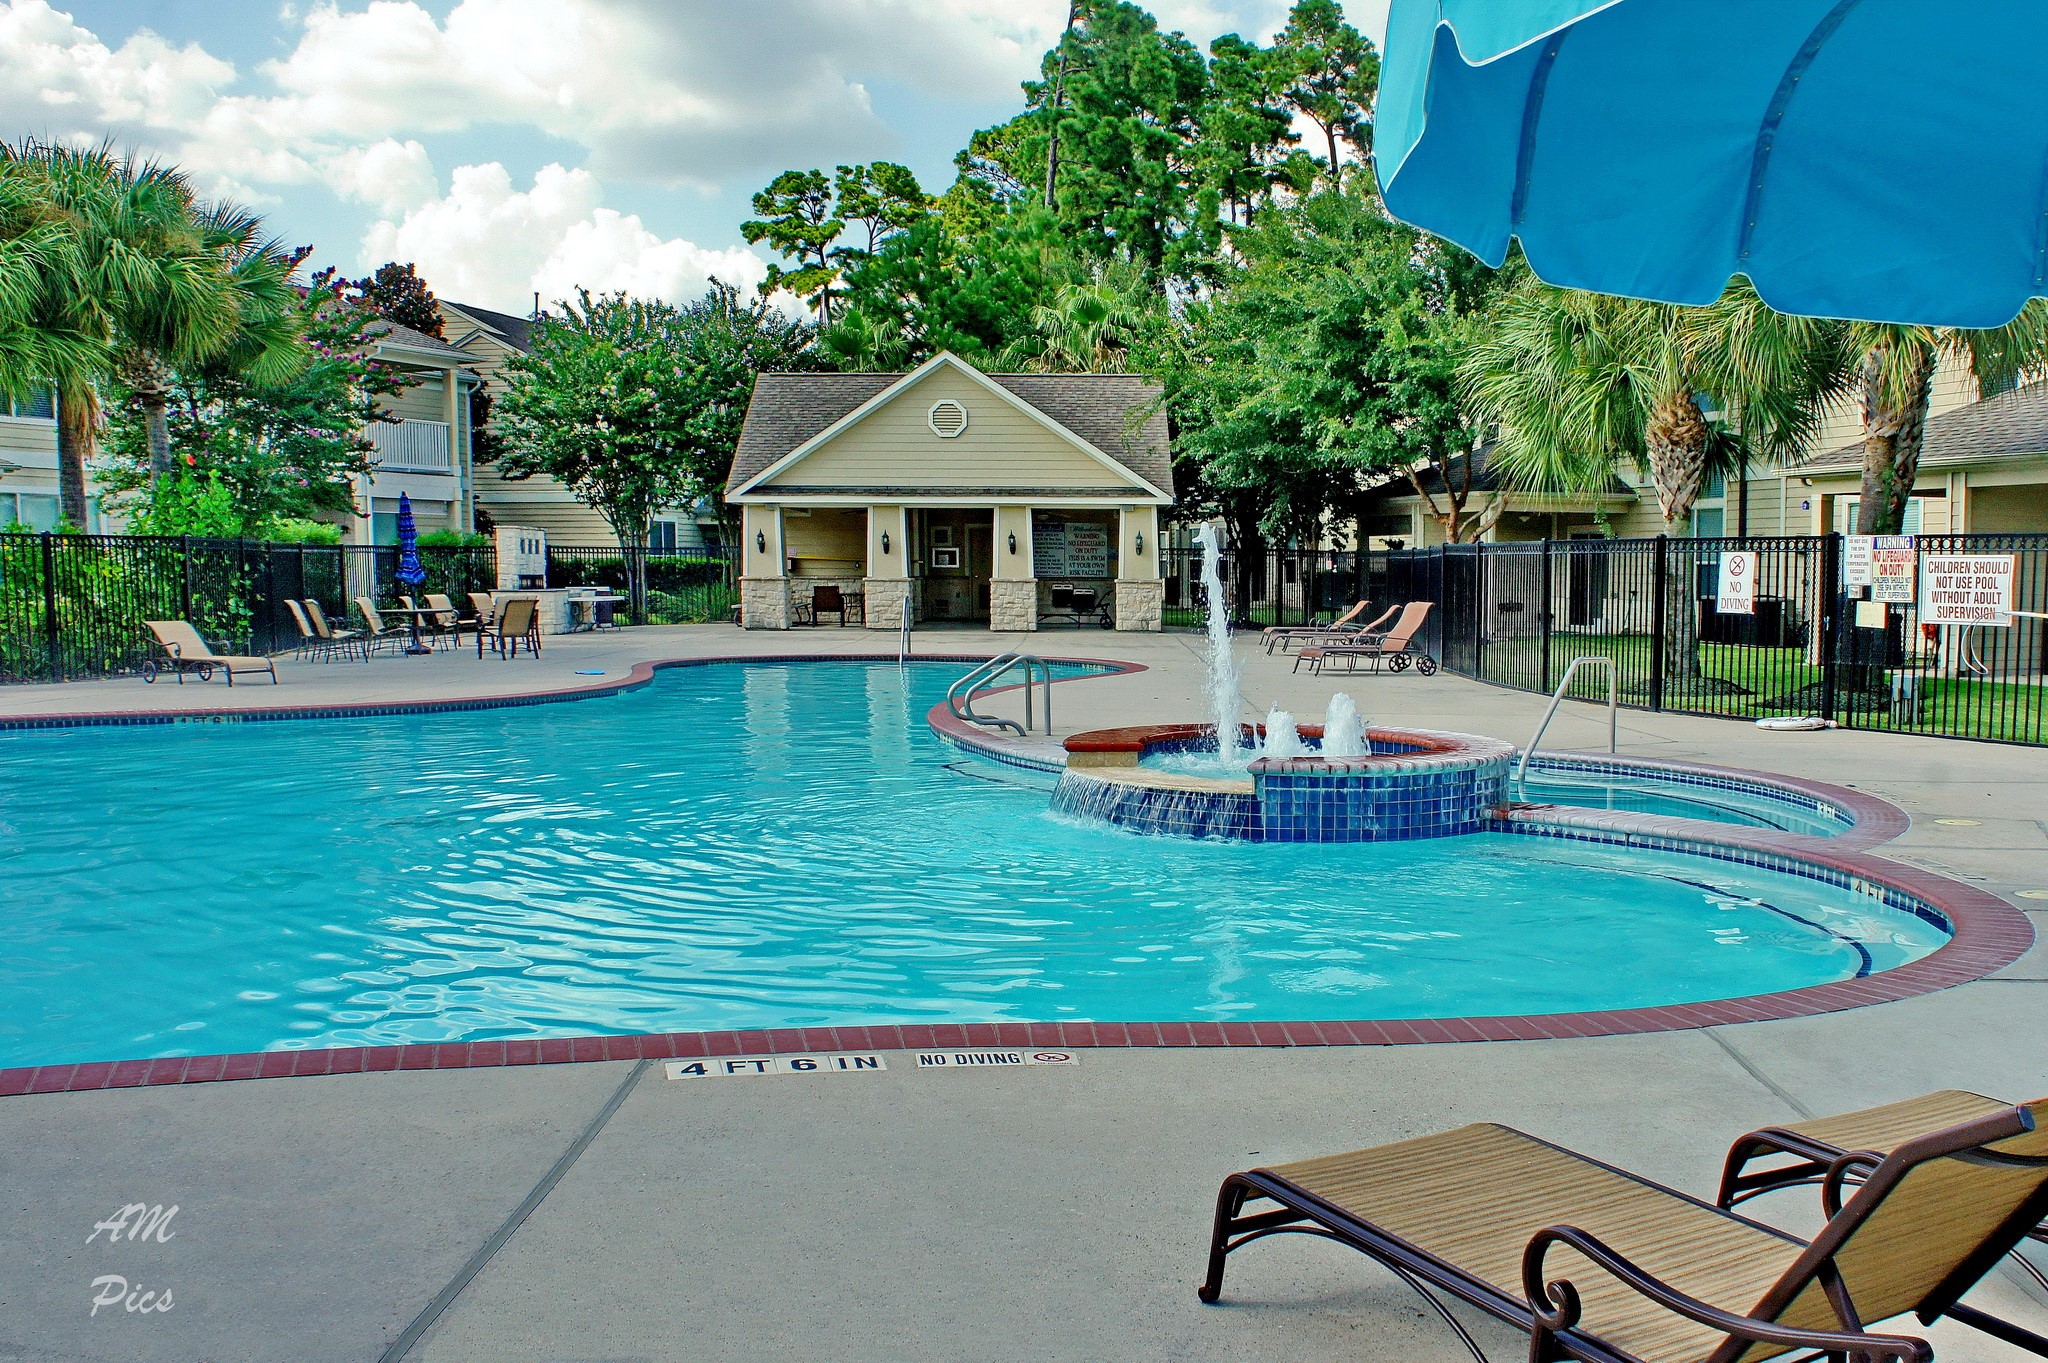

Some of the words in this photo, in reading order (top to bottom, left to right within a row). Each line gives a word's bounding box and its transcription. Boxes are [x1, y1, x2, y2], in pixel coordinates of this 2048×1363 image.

[1877, 537, 1910, 549] WARNING
[1873, 551, 1881, 562] NO
[1883, 551, 1911, 562] LIFEGUARD
[1880, 564, 1888, 575] ON
[1889, 564, 1904, 575] DUTY
[1928, 561, 1971, 573] CHILDREN
[1973, 562, 2009, 574] SHOULD
[1730, 581, 1741, 593] NO
[1936, 576, 1953, 588] NOT
[1956, 576, 1972, 589] USE
[1975, 576, 1998, 589] POOL
[1721, 597, 1749, 610] DIVING
[1932, 591, 1971, 603] WITHOUT
[1974, 591, 2001, 604] ADULT
[1937, 606, 1996, 619] SUPERVISION
[1868, 883, 1881, 900] FT
[681, 1063, 708, 1075] 4
[726, 1060, 770, 1073] FT
[791, 1058, 818, 1070] 6
[838, 1056, 879, 1069] IN
[920, 1054, 946, 1065] NO
[955, 1053, 1021, 1065] DIVING
